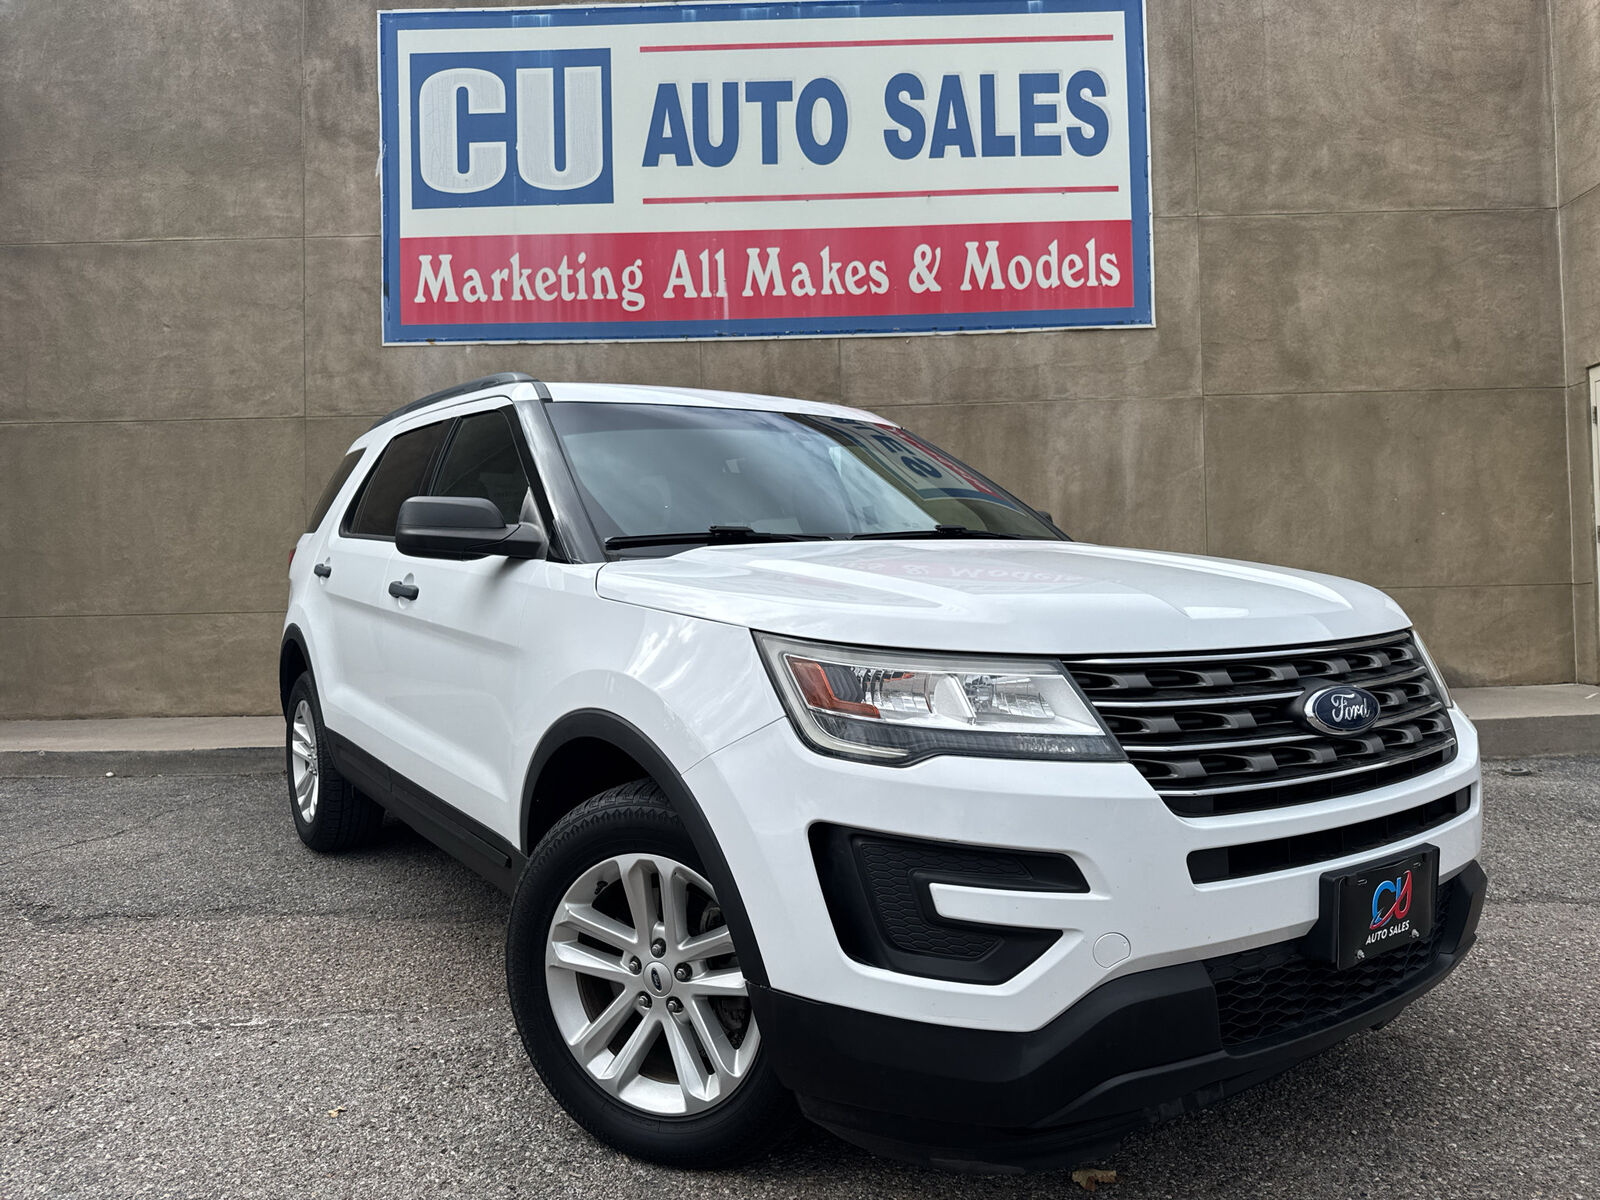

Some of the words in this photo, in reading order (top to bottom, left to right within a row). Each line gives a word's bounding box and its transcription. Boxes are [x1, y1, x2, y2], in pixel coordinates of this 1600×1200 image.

[419, 66, 604, 194] CU
[641, 78, 848, 168] AUTO
[883, 69, 1109, 161] SALES
[413, 251, 646, 312] Marketing
[663, 247, 725, 299] All
[742, 245, 889, 298] Makes
[908, 243, 942, 294] &
[960, 237, 1121, 292] Models
[1330, 693, 1371, 723] Ford
[1365, 928, 1388, 945] AUTO
[1388, 919, 1410, 937] SALES
